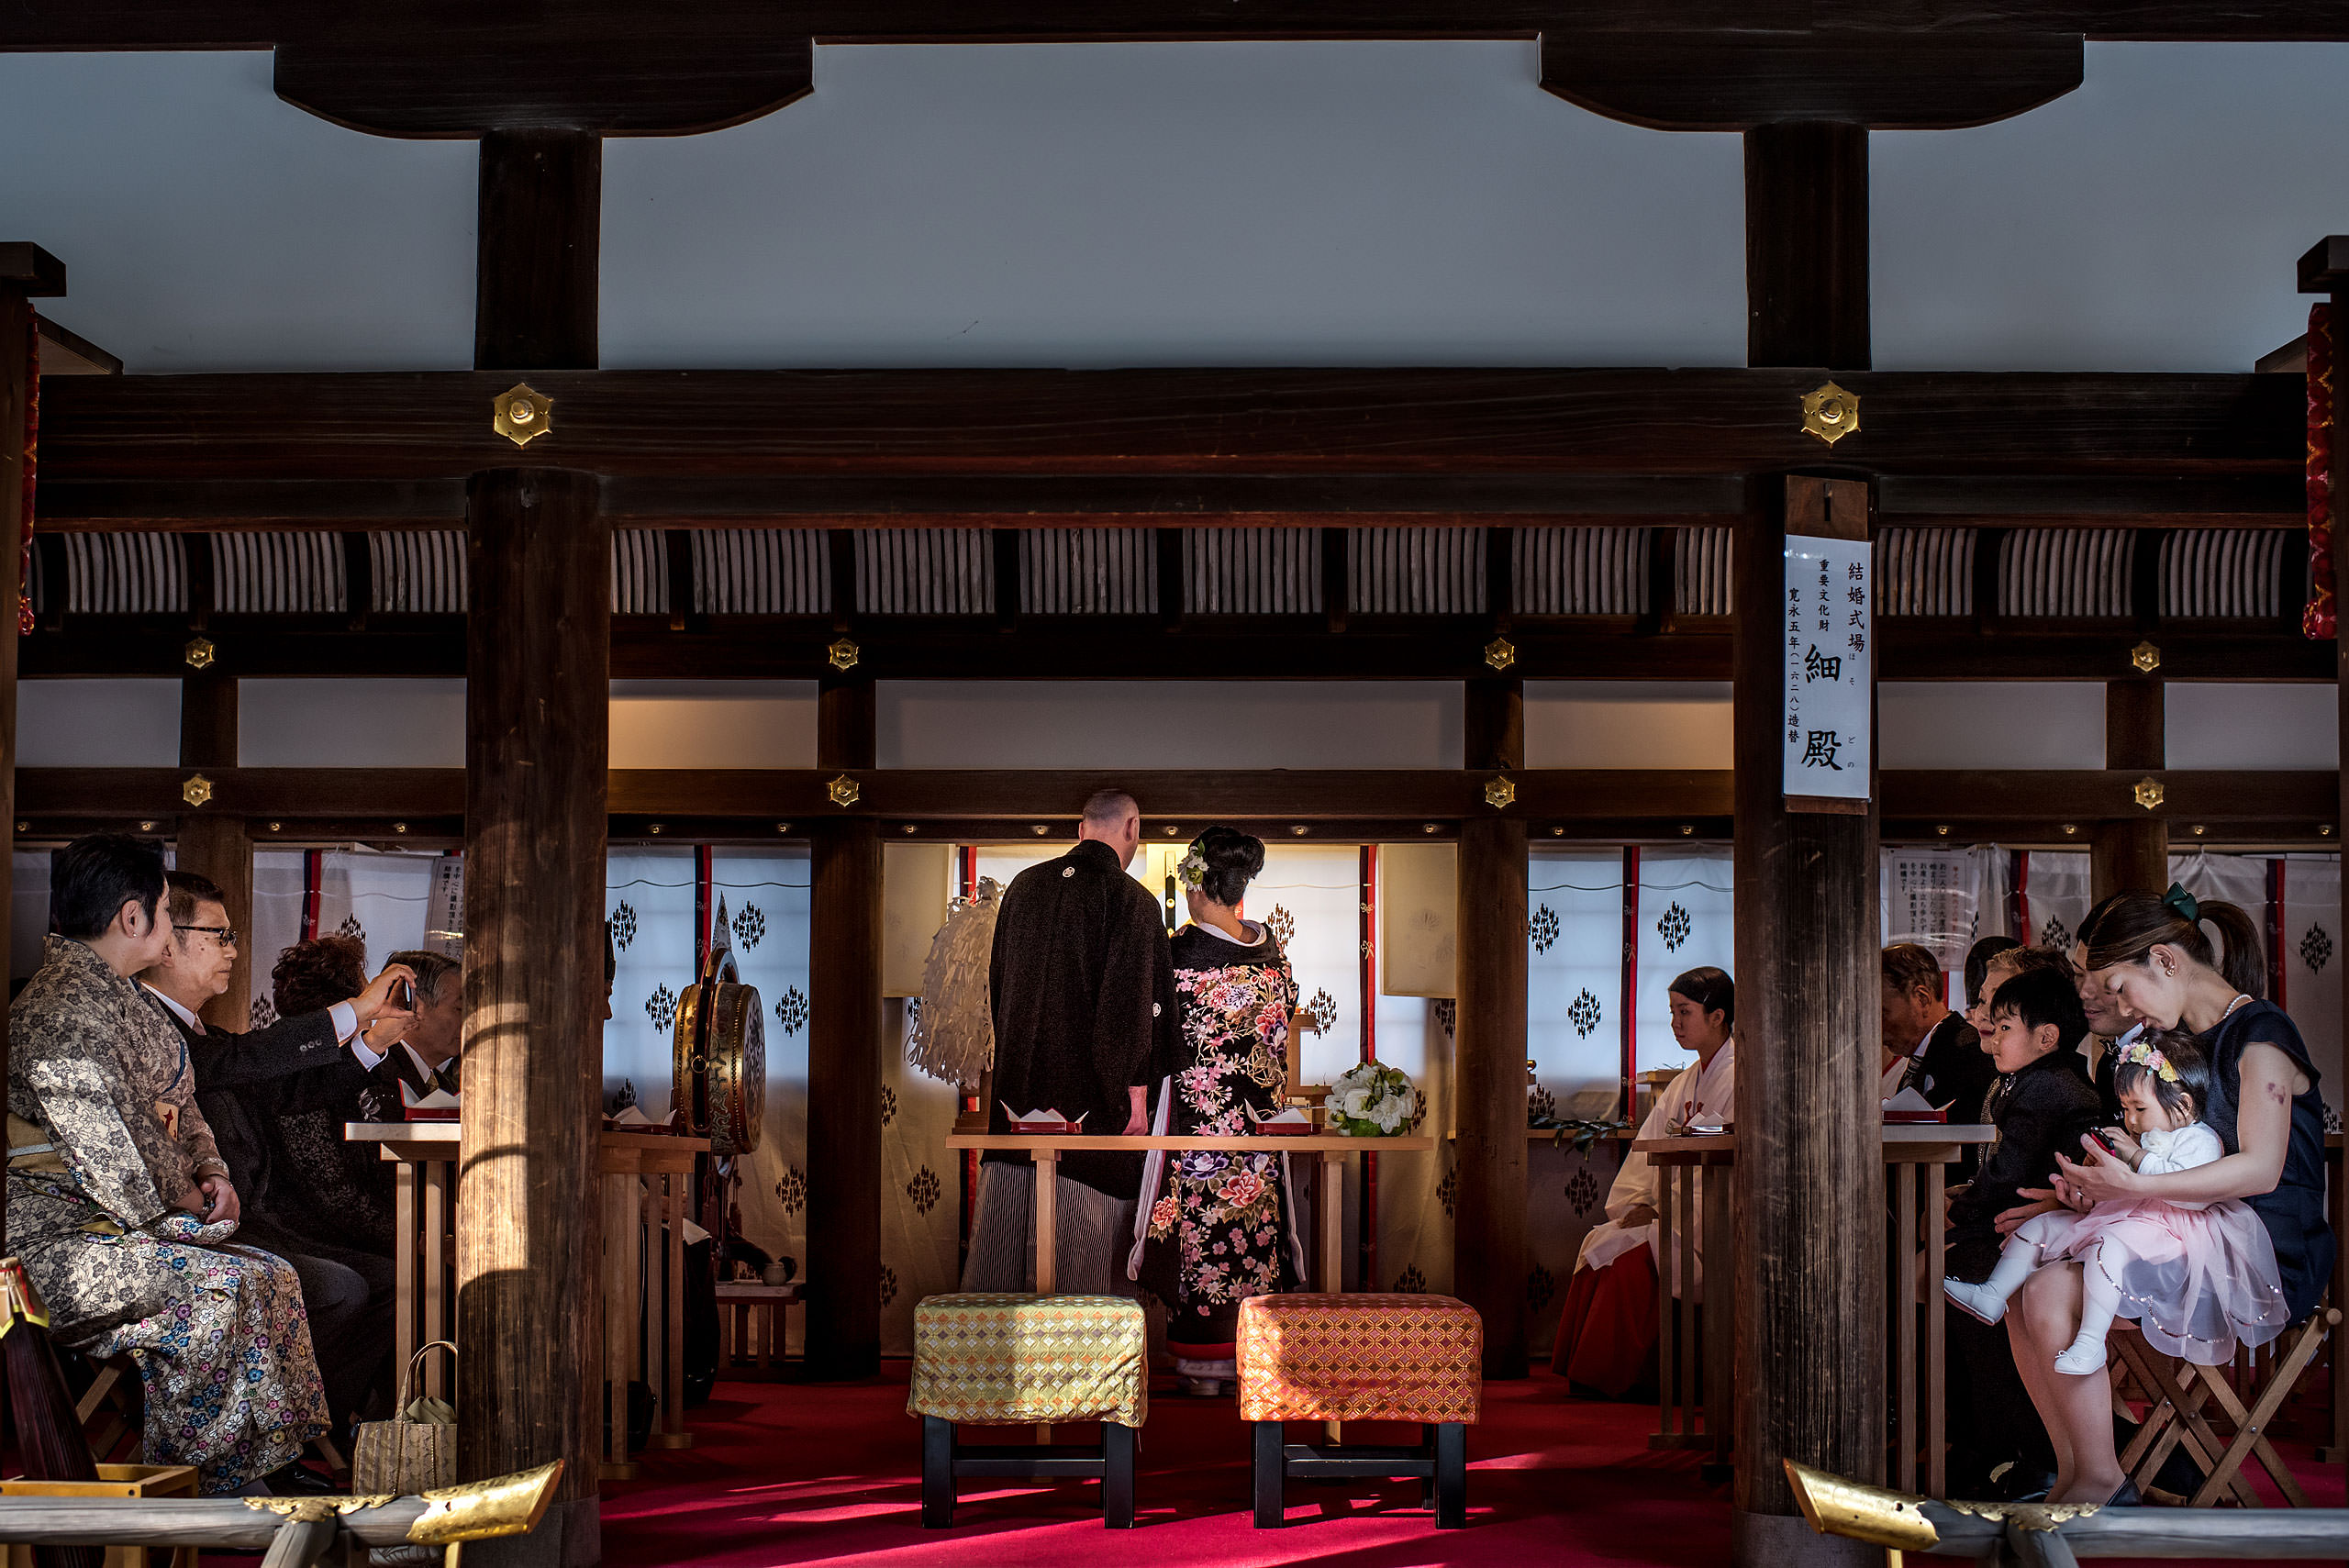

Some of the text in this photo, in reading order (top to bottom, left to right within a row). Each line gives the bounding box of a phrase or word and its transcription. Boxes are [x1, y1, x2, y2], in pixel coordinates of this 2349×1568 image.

[1818, 559, 1831, 632] 重要文化財
[1846, 562, 1865, 653] 結婚式場
[1800, 643, 1842, 771] 細殿
